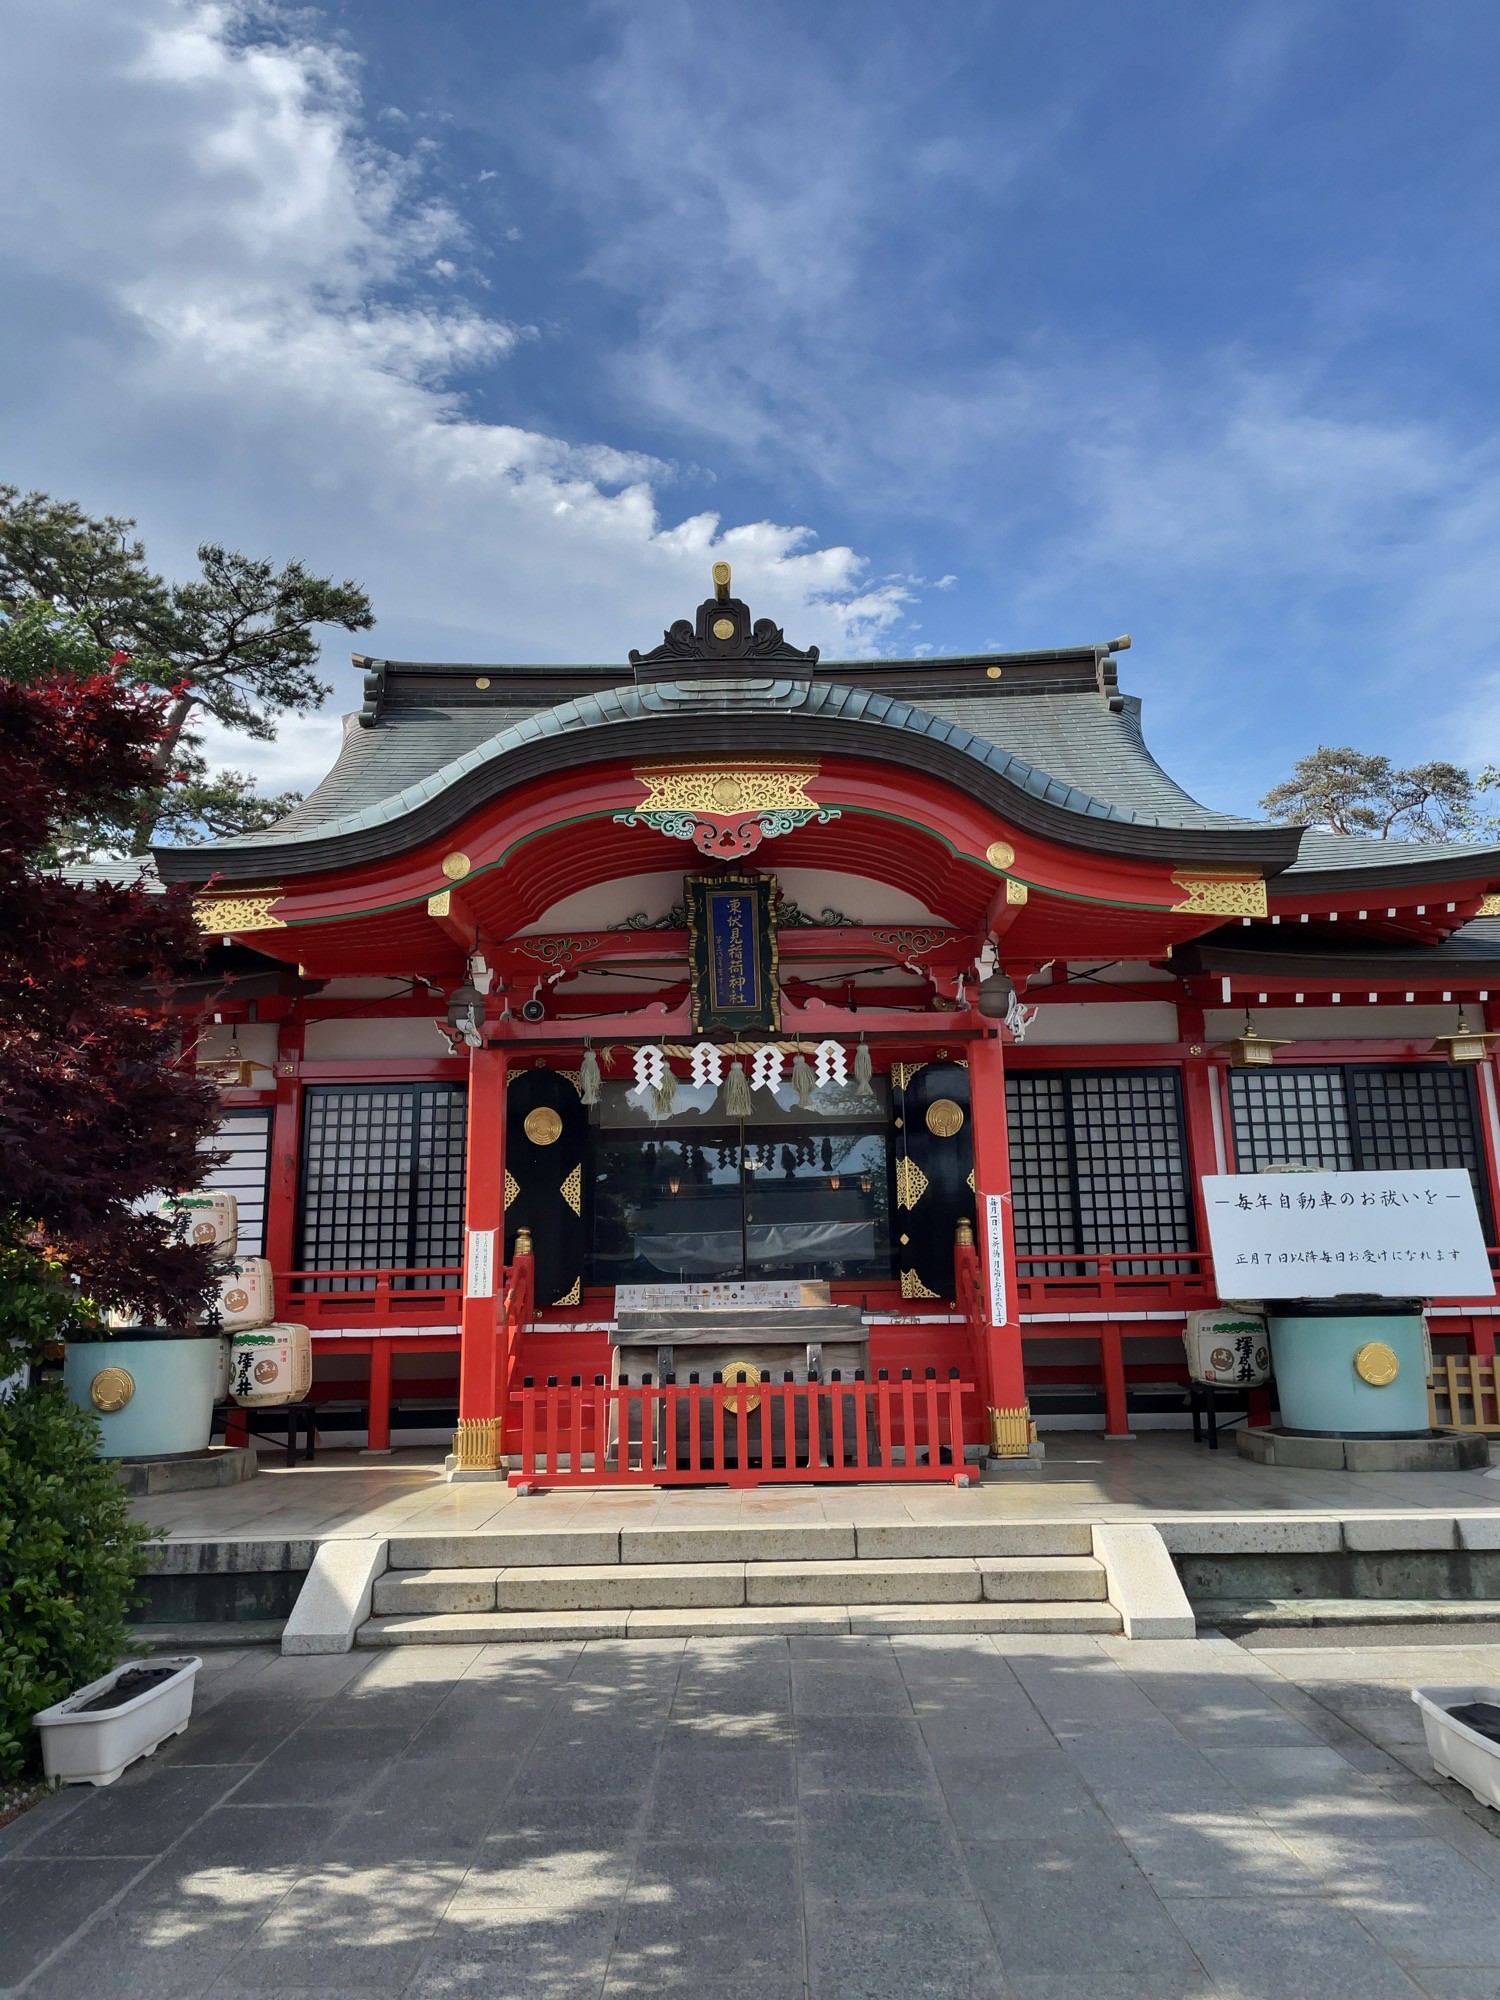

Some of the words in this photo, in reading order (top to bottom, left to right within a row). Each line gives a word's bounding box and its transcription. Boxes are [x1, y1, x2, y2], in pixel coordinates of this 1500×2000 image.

[235, 1351, 254, 1396] 澤乃井
[1235, 1336, 1256, 1382] 澤乃井
